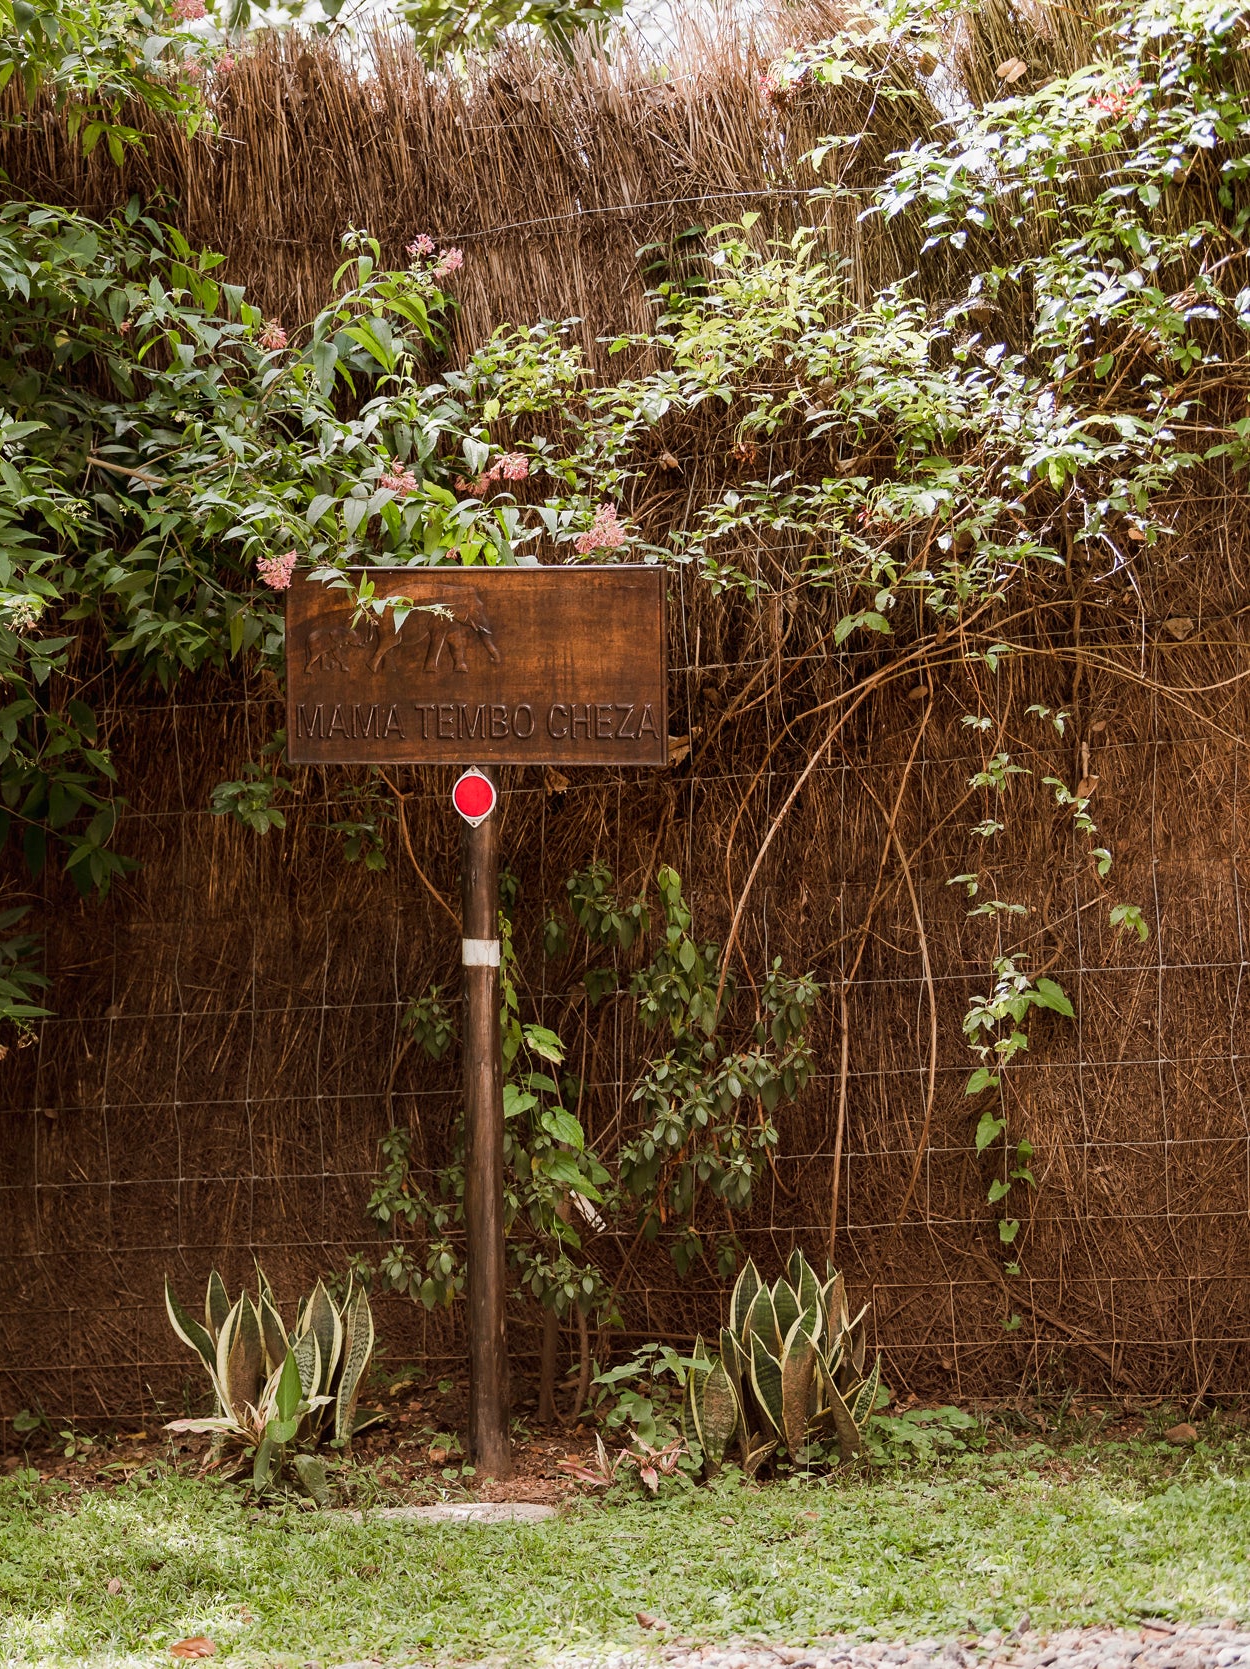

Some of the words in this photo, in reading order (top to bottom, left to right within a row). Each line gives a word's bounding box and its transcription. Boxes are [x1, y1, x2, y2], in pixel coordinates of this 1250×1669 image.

[296, 704, 406, 739] MAMA
[415, 703, 535, 739] TEMBO
[547, 703, 660, 739] CHEZA
